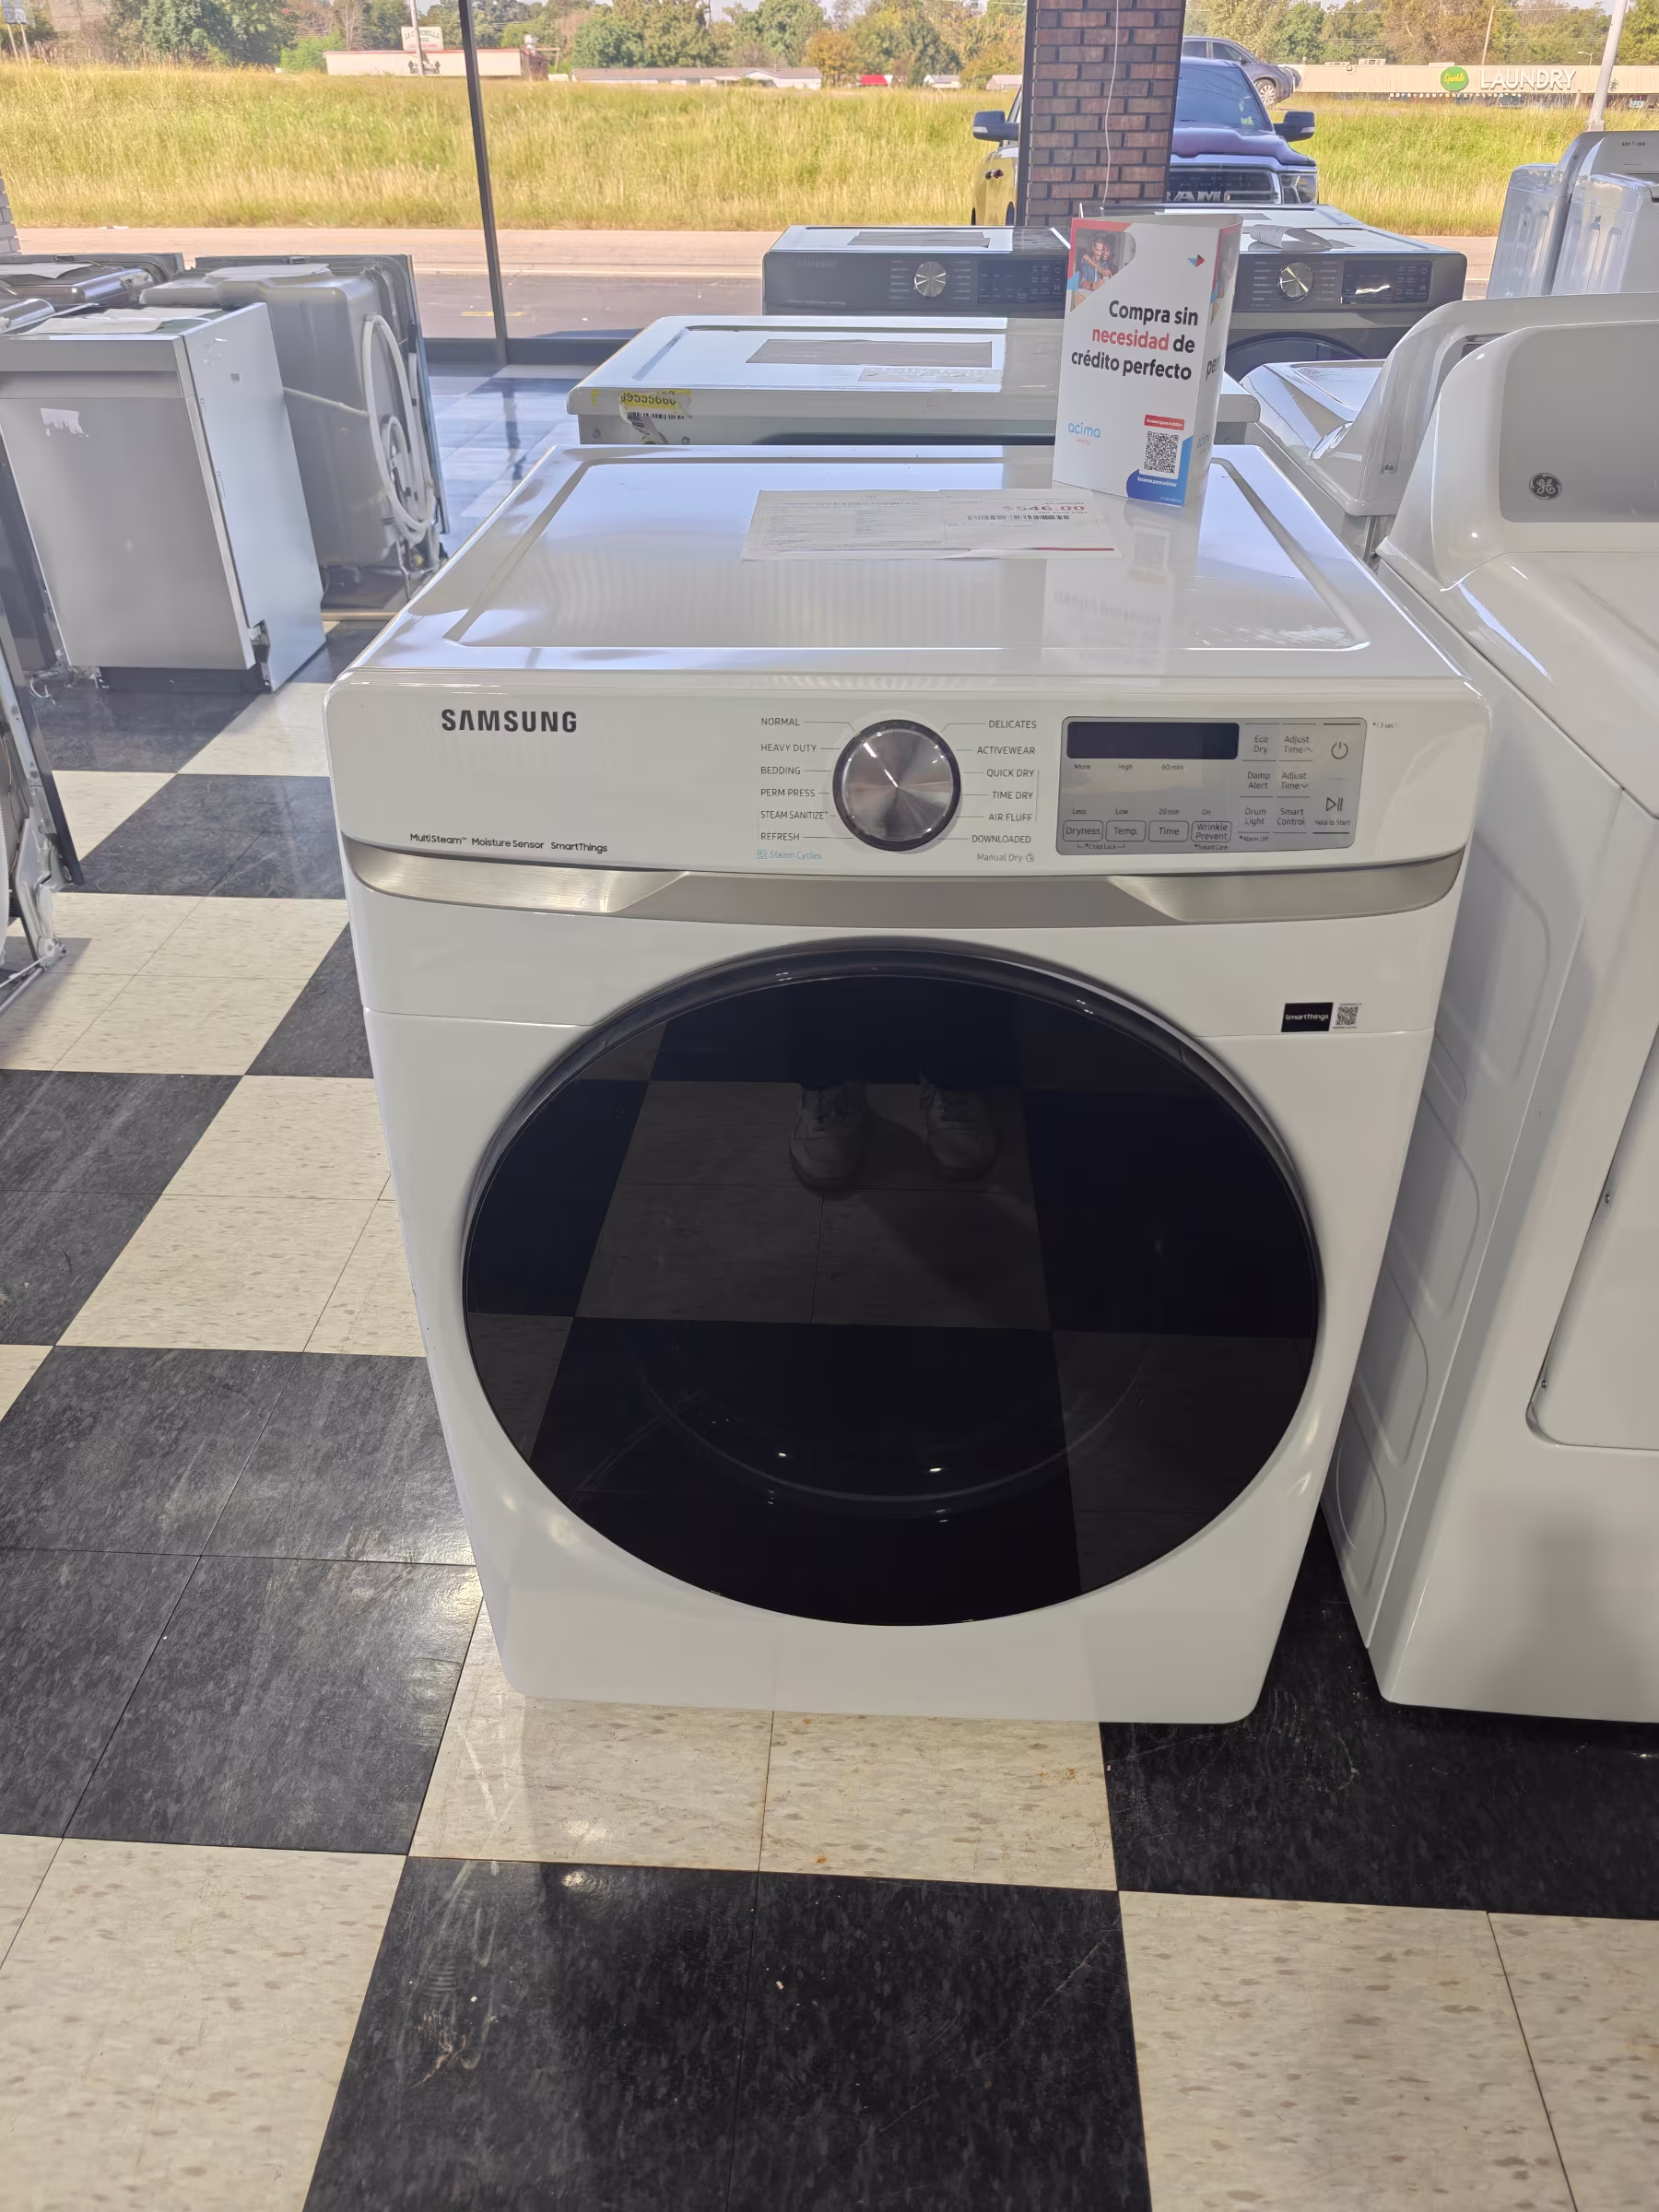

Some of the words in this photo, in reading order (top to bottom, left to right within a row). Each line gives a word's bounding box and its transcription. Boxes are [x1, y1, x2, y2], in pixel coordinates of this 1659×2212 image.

[1480, 68, 1576, 90] LAUNDRY
[1109, 300, 1171, 325] Compra
[1173, 307, 1198, 325] sin
[1091, 329, 1170, 351] necesidad
[1172, 335, 1195, 353] de
[1071, 350, 1120, 371] crédito
[1123, 359, 1192, 381] perfecto
[1067, 422, 1101, 439] acima
[441, 709, 577, 733] SAMSUNG
[761, 718, 801, 726] NORMAL
[988, 720, 1037, 729] DELICATES
[1284, 735, 1310, 744] Adjust
[760, 744, 791, 752] HEAVY
[793, 744, 817, 753] DUTY
[977, 746, 1036, 755] ACTIVEWEAR
[1253, 746, 1267, 754] Dry
[1284, 746, 1302, 754] Time
[760, 766, 801, 775] BEDDING
[1117, 763, 1134, 771] High
[986, 769, 1015, 778] QUICK
[1016, 769, 1034, 777] DRY
[1247, 771, 1270, 780] Damp
[1281, 771, 1307, 781] Adjust
[1248, 782, 1268, 790] Alert
[760, 788, 785, 797] PERM
[787, 789, 816, 797] PRESS
[992, 791, 1014, 800] TIME
[1015, 791, 1033, 800] DRY
[760, 811, 788, 819] STEAM
[1244, 807, 1266, 816] Drum
[1279, 807, 1304, 816] Smart
[988, 813, 1004, 821] AIR
[1006, 813, 1033, 822] FLUFF
[1277, 818, 1305, 826] Control
[1196, 823, 1229, 831] Wrinkle
[1244, 818, 1265, 827] Light
[1065, 827, 1100, 836] Dryness
[1113, 827, 1139, 836] Temp.
[1159, 827, 1180, 836] Time
[760, 832, 800, 841] REFRESH
[971, 834, 1031, 843] DOWNLOADED
[1195, 832, 1228, 841] Prevent
[472, 837, 512, 848] Moisture
[512, 840, 545, 850] Sensor
[550, 841, 608, 854] SmartThings
[770, 851, 794, 859] Steam
[796, 851, 822, 860] Cycles
[977, 853, 1006, 862] Manual
[1008, 853, 1023, 863] Dry
